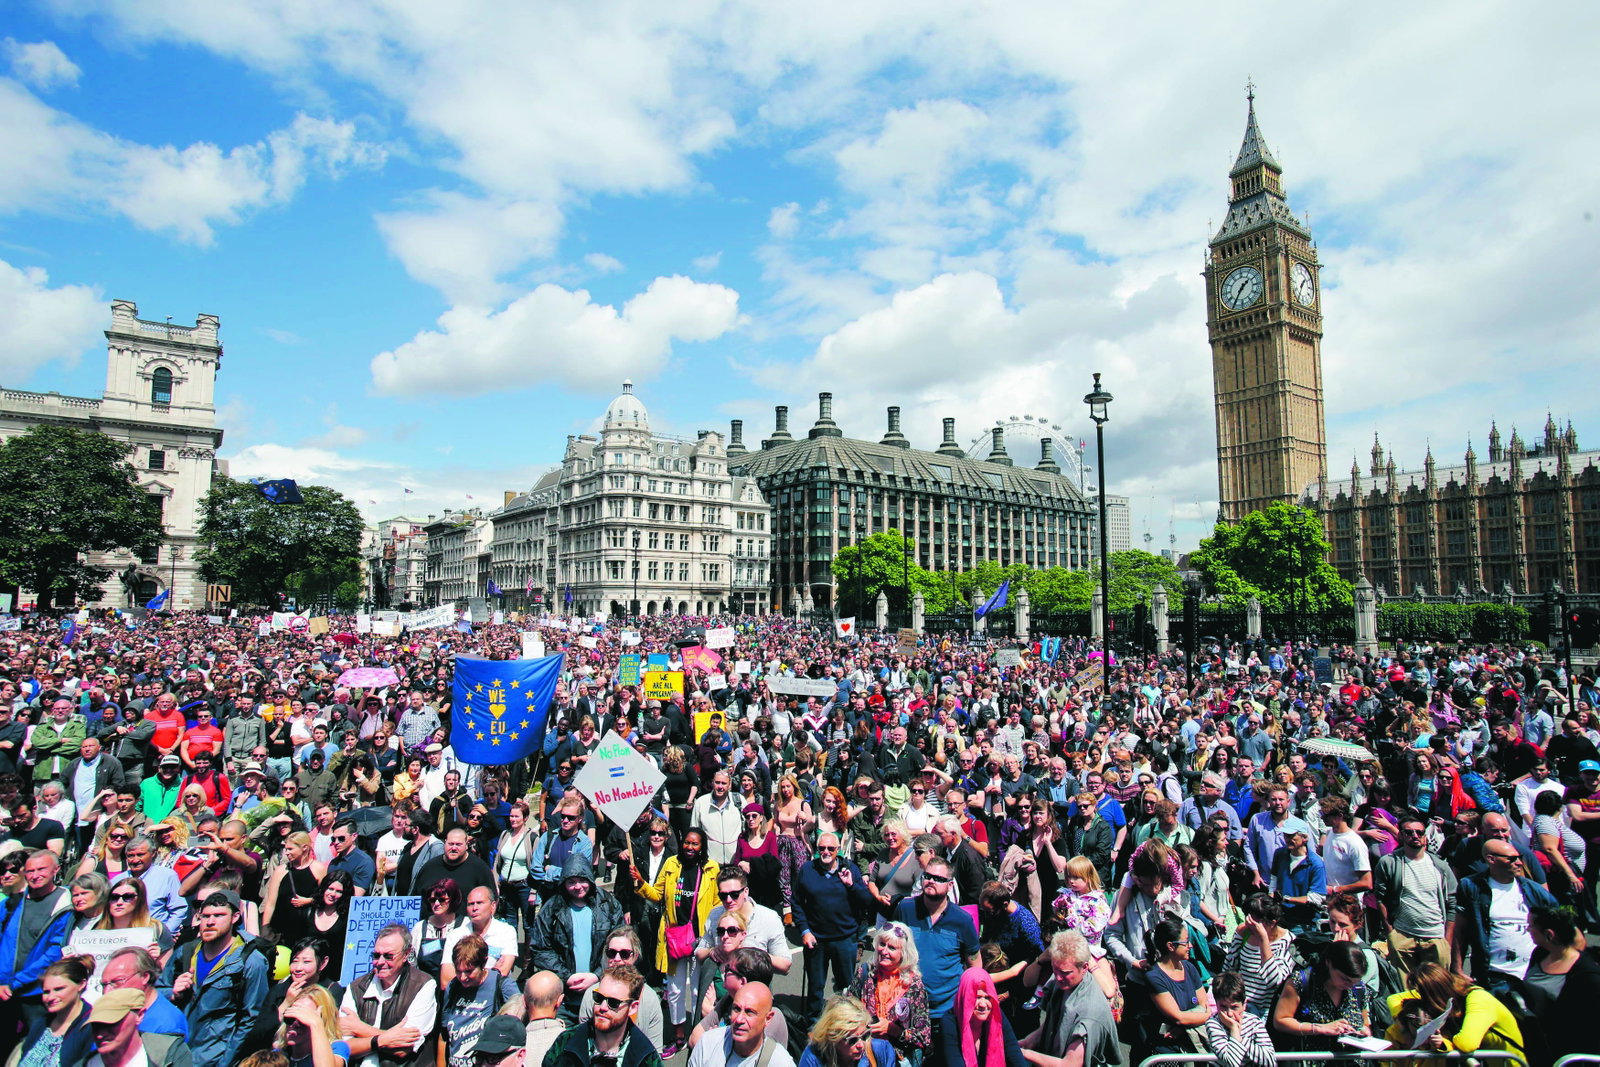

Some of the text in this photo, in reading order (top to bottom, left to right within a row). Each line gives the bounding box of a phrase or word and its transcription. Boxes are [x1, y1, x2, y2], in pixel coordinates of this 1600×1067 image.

[210, 585, 229, 601] IN
[659, 673, 669, 681] WE
[488, 689, 506, 703] WE
[490, 721, 506, 735] EU
[599, 746, 613, 760] No
[594, 780, 654, 805] No Mandate
[354, 898, 421, 911] MY FUTURE
[360, 910, 406, 919] SHOULD BE
[100, 937, 128, 945] EUROPE
[456, 997, 488, 1010] Original
